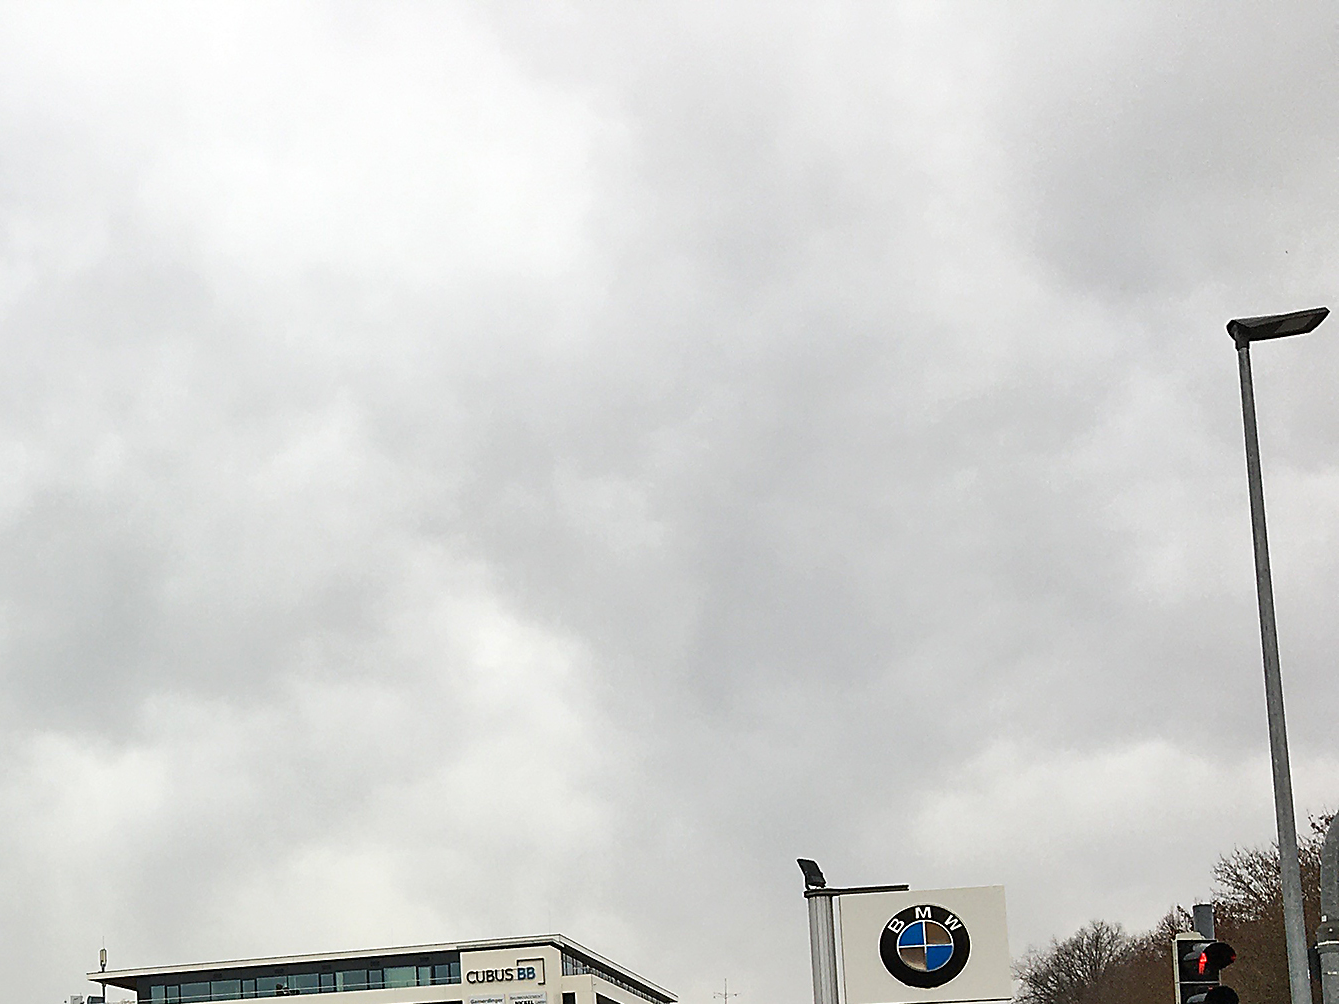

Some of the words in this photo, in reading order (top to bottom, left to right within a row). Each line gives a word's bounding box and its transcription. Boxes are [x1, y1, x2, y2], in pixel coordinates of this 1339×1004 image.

[887, 907, 962, 933] BMW
[466, 968, 514, 984] CUBUS
[517, 967, 536, 980] BB
